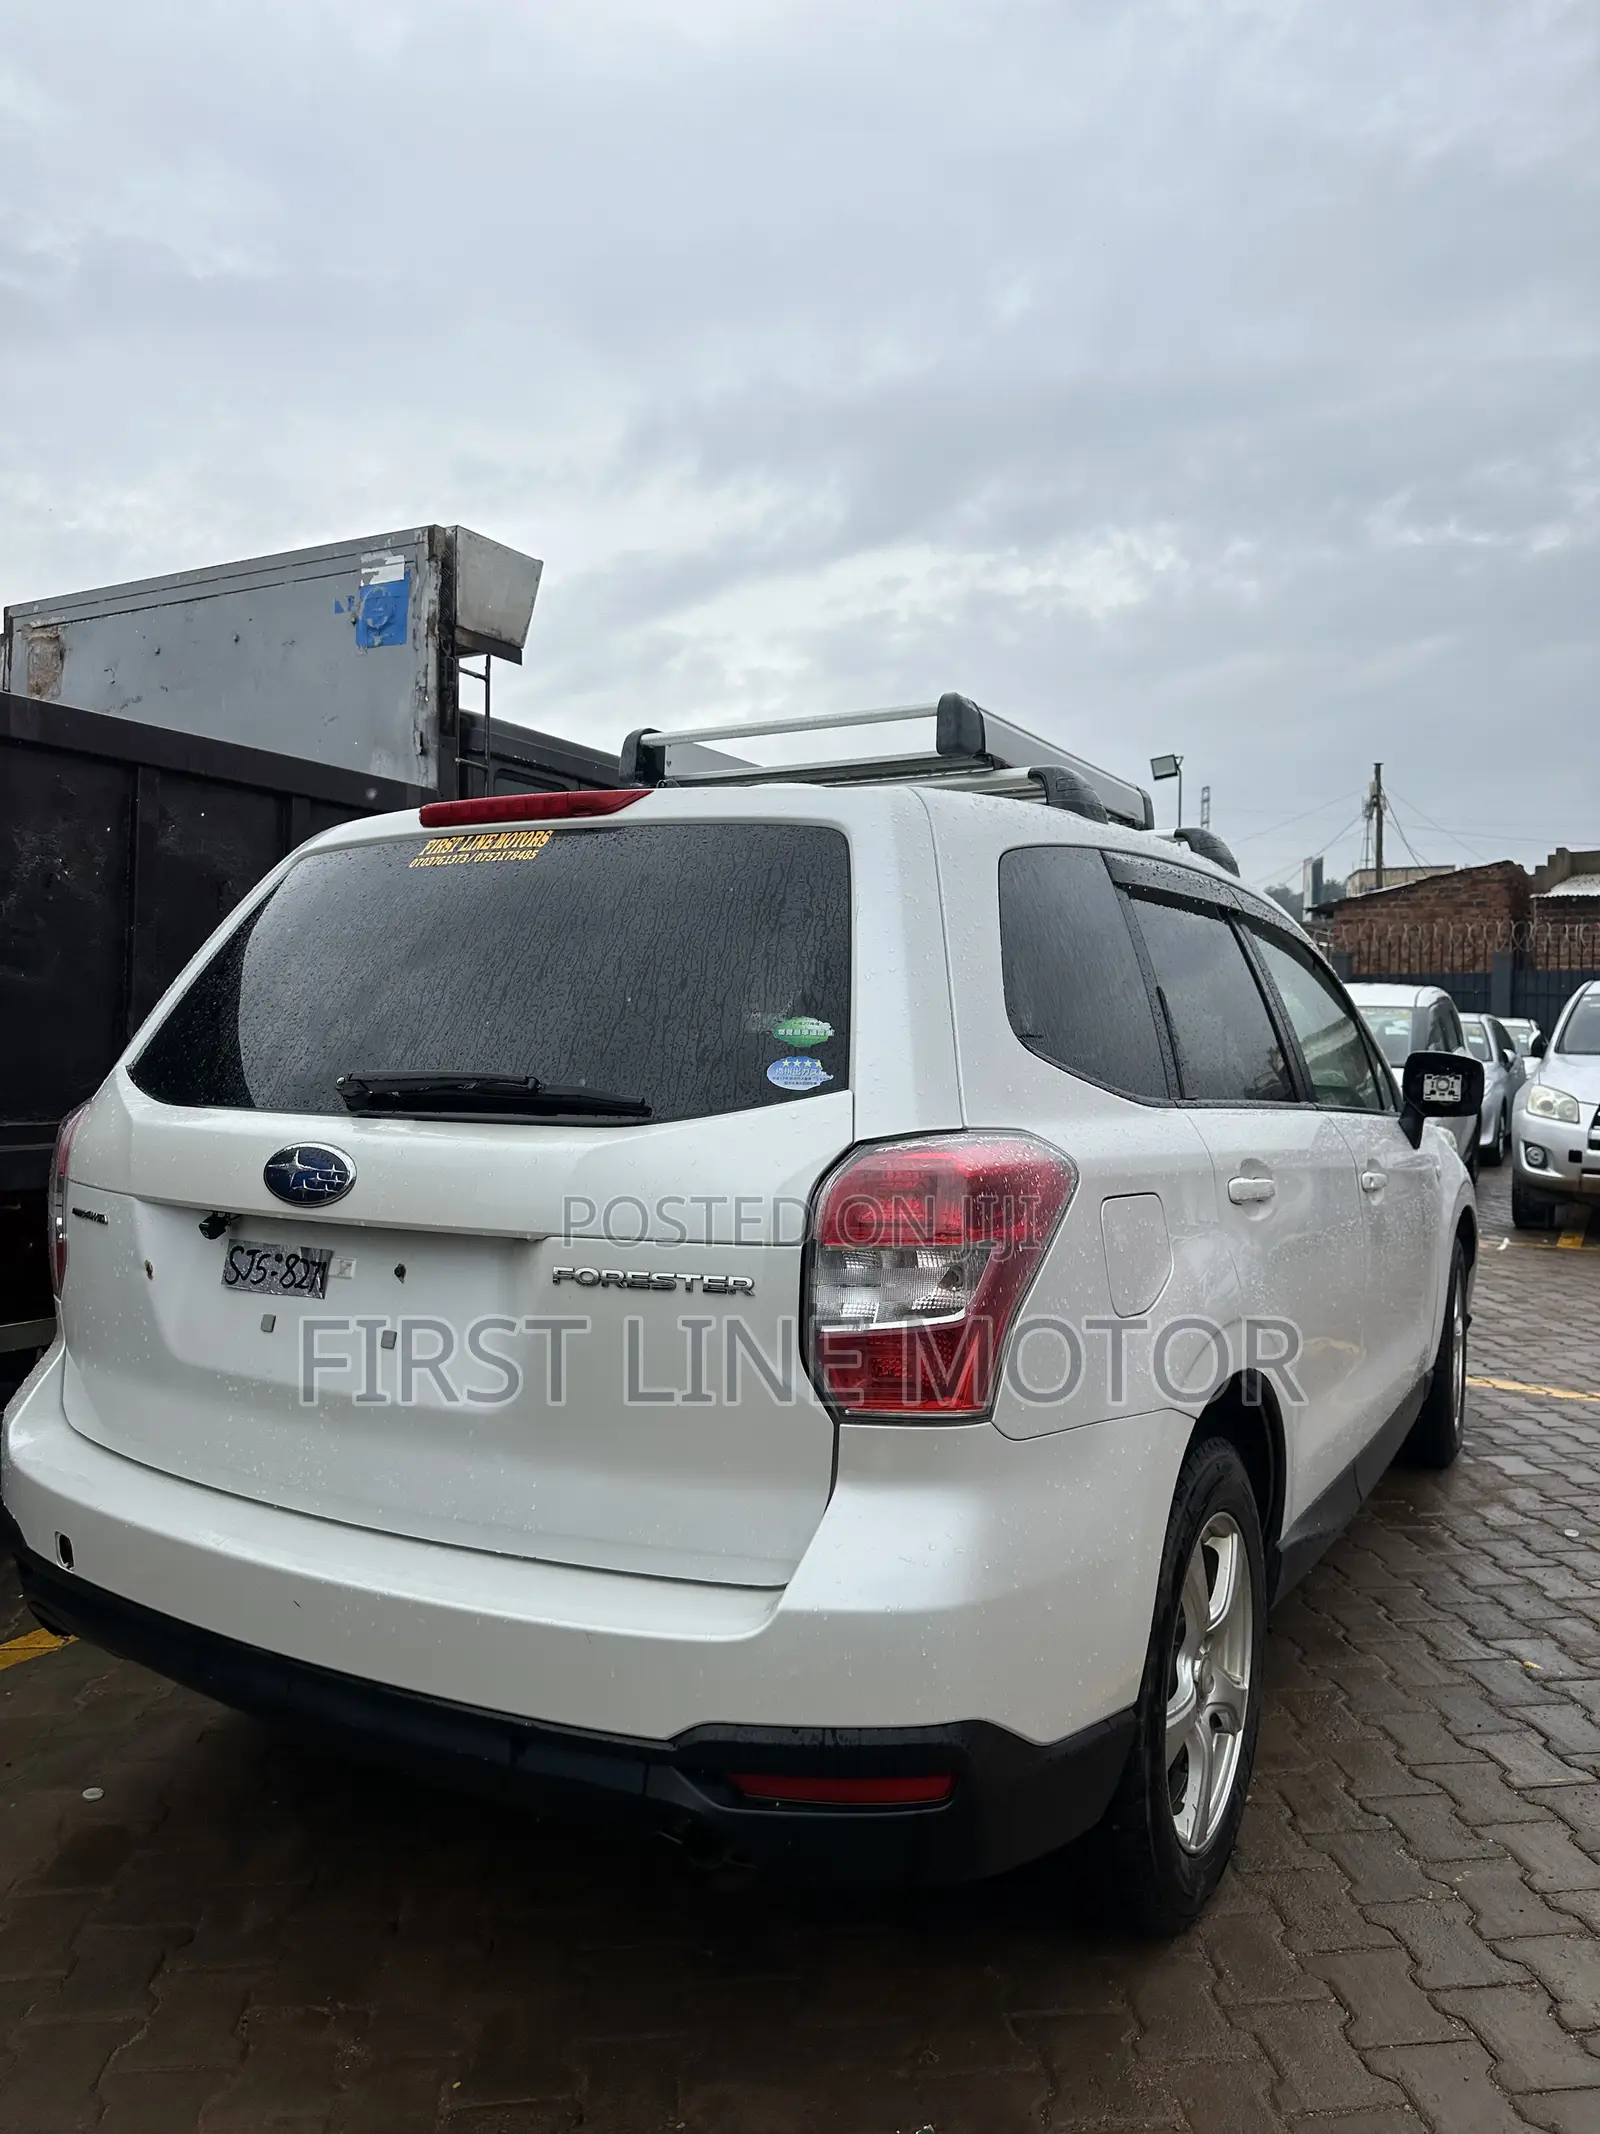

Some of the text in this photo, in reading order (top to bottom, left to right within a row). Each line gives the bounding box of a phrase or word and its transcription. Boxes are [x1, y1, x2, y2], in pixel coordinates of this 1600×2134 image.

[418, 830, 554, 856] FIRST LINE MOTORS
[552, 1266, 755, 1297] FORESTER
